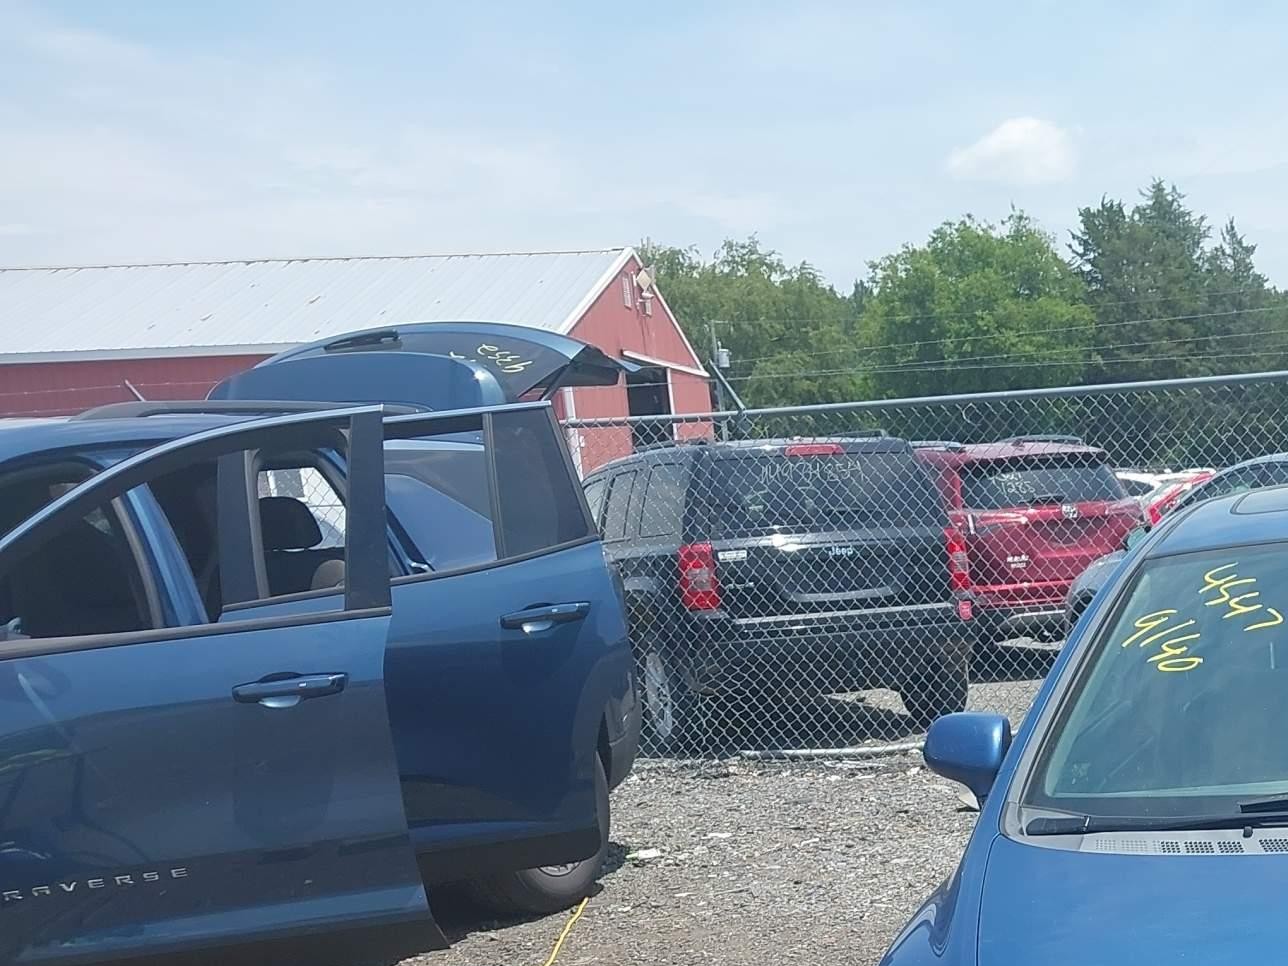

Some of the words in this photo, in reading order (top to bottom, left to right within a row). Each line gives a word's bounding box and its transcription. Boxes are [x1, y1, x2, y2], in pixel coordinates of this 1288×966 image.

[828, 545, 854, 556] Jeep
[1199, 561, 1284, 632] 4547
[2, 867, 188, 901] RAVERSE
